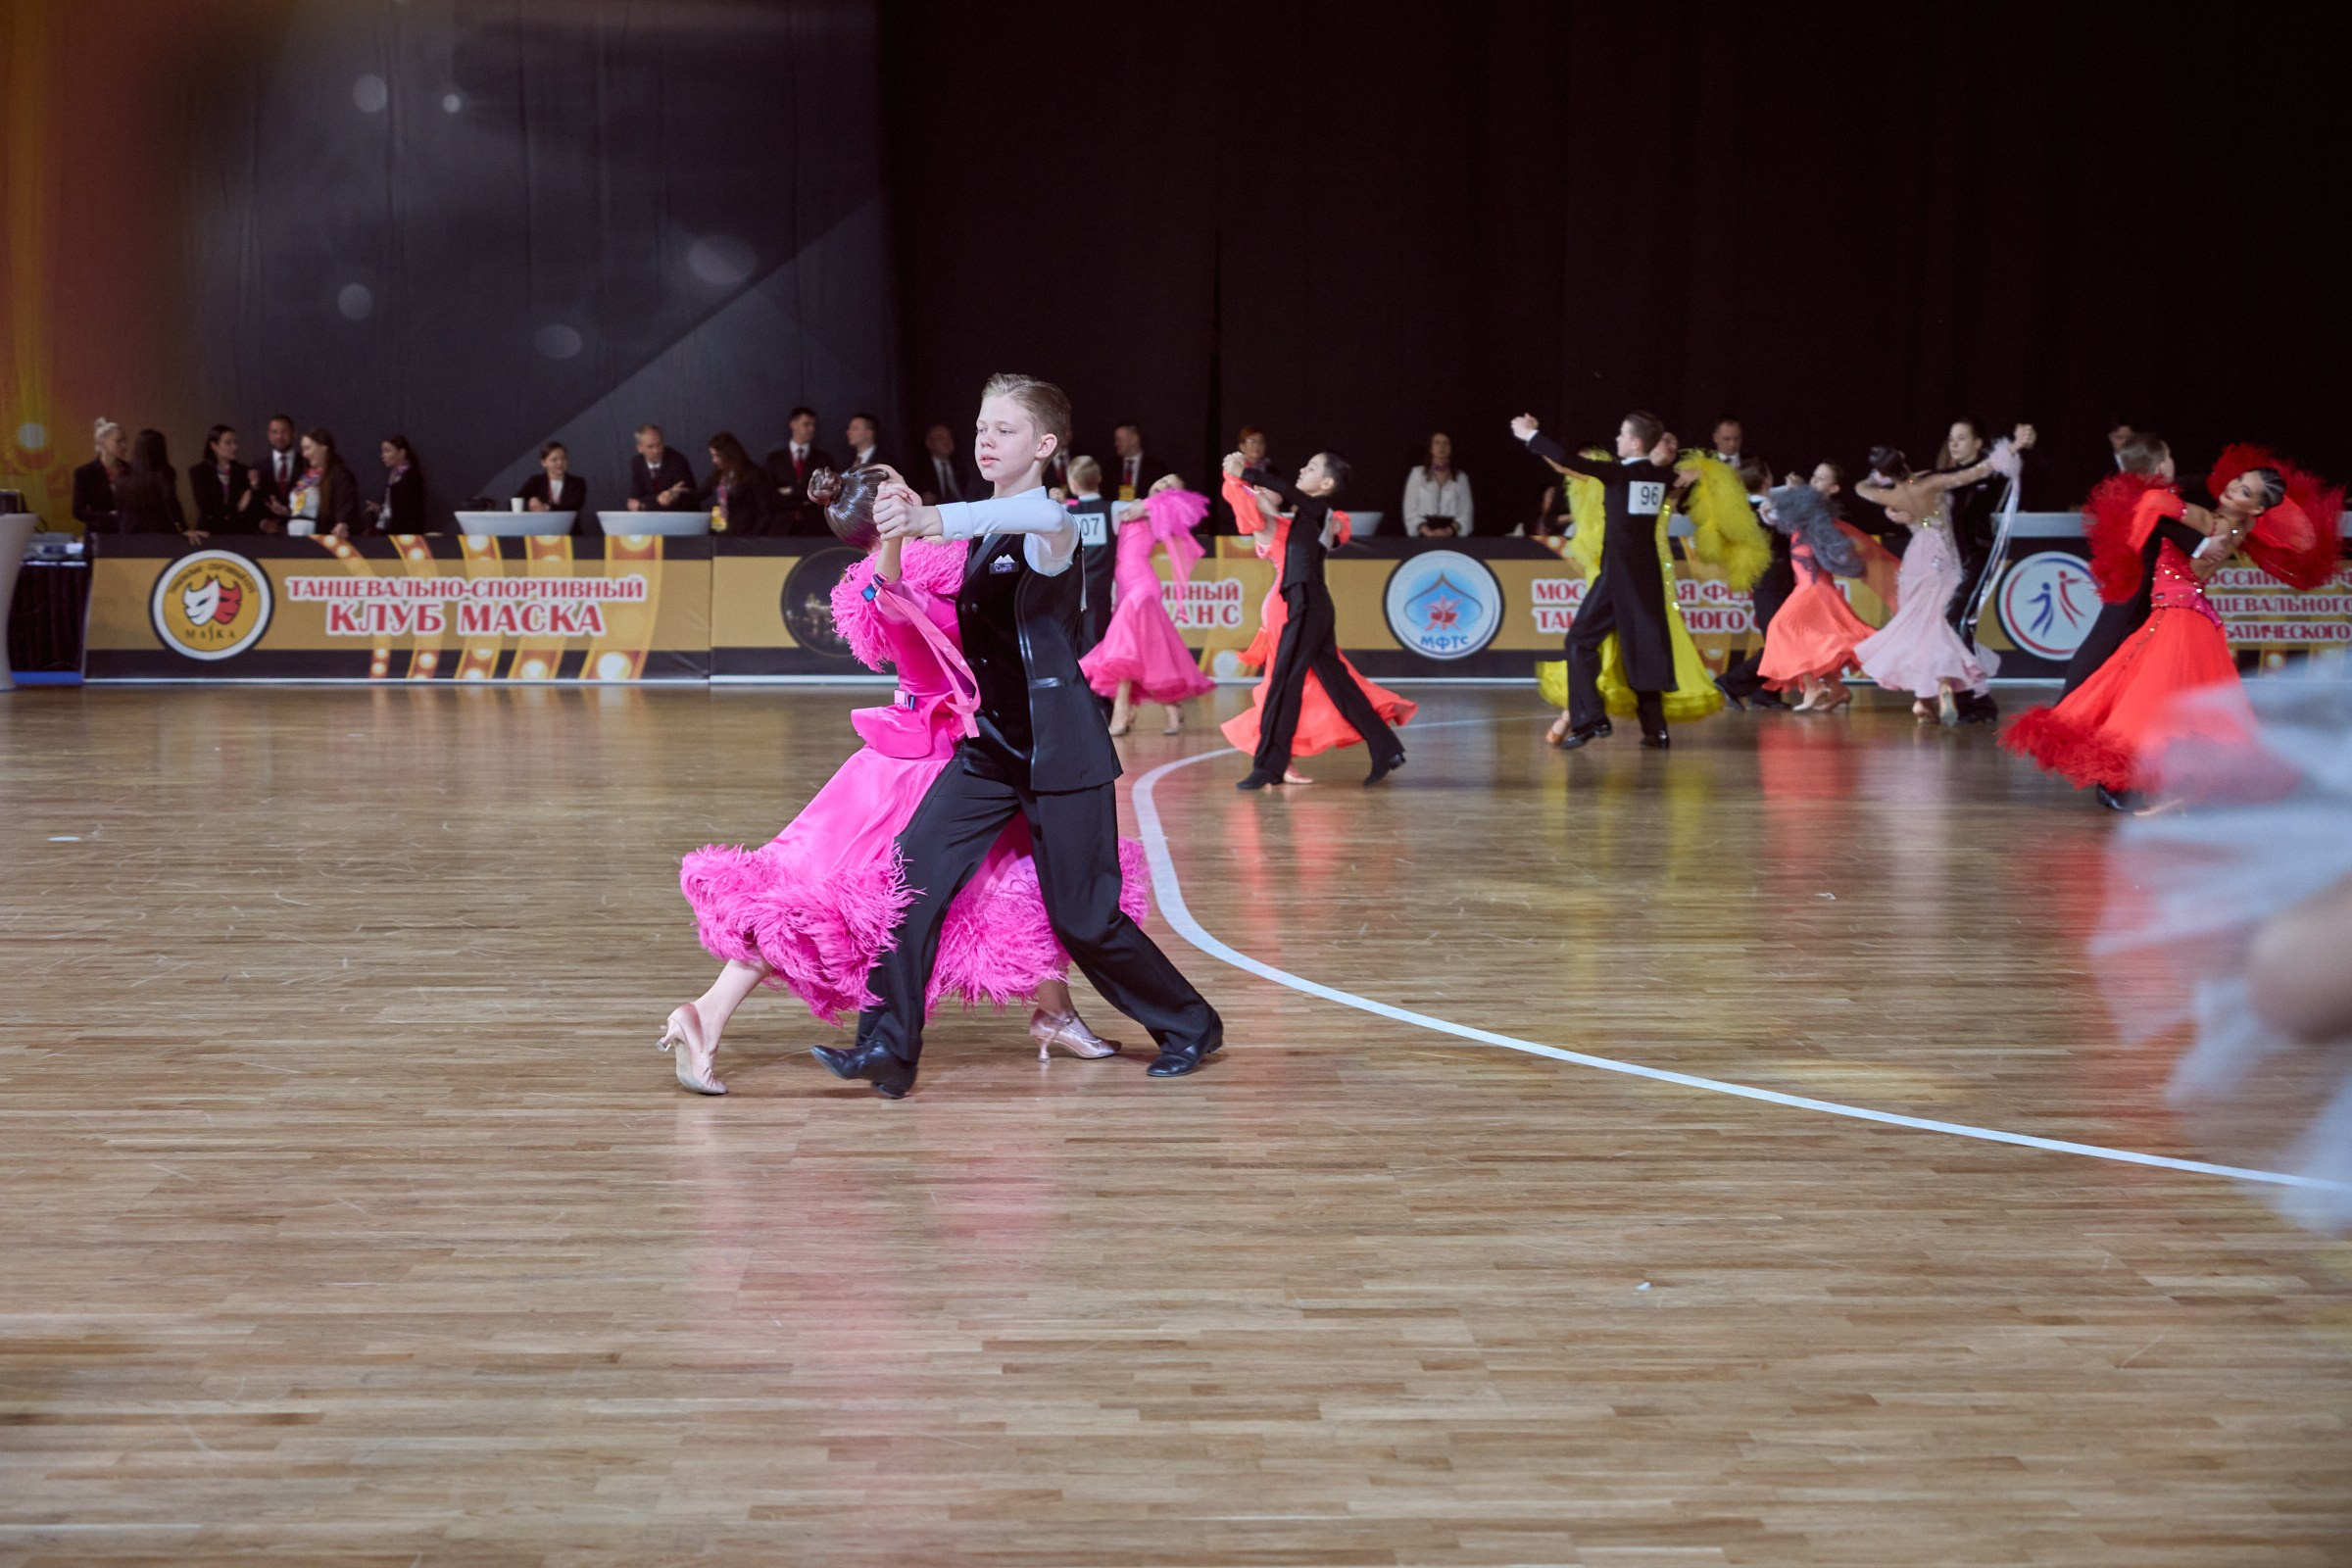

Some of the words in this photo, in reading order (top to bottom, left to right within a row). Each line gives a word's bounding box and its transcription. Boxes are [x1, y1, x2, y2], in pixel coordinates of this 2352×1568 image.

[1641, 486, 1658, 506] 96
[288, 577, 643, 599] ТАНЦЕВАЛЬНО-СПОРТИВНЫЙ
[1163, 582, 1239, 601] ИВНЫЙ
[2211, 597, 2352, 612] ЦЕВАЛЬНОГО
[330, 604, 442, 631] КЛУБ
[461, 604, 603, 632] МАСКА
[1174, 605, 1239, 624] АНС
[2227, 624, 2351, 639] БАТИЧЕСКОГО
[1420, 635, 1469, 650] МФТС
